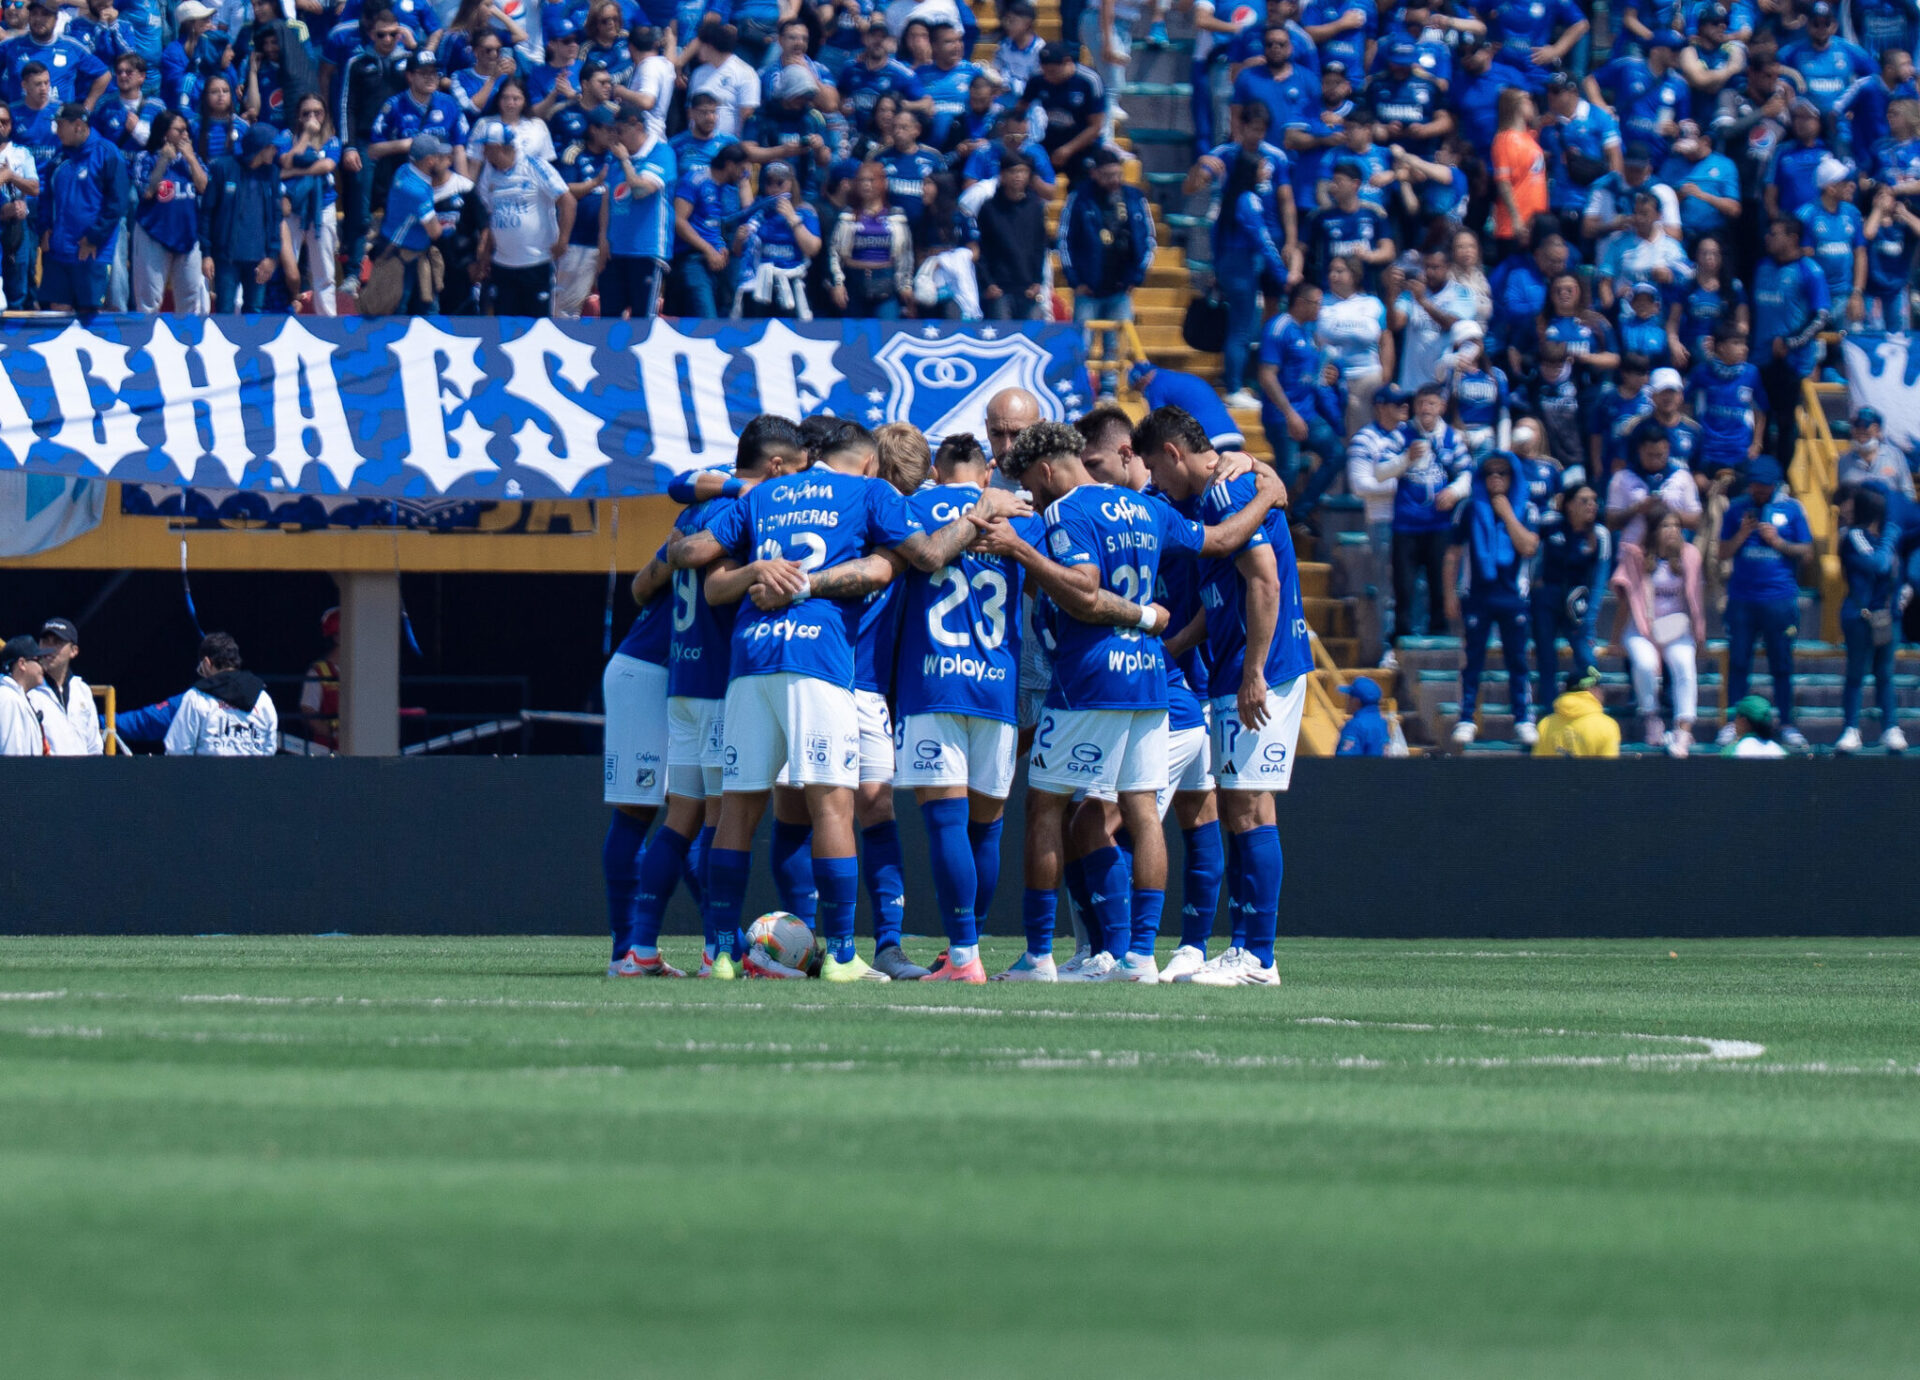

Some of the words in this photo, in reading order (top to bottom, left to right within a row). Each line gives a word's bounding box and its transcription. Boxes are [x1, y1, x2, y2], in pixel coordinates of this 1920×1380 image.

[387, 316, 613, 495] ES
[1118, 531, 1158, 551] VALENCI
[929, 565, 1007, 649] 23
[1220, 719, 1240, 752] 17
[913, 760, 944, 770] GAC
[1067, 762, 1103, 774] GAC
[1260, 764, 1286, 773] GAC
